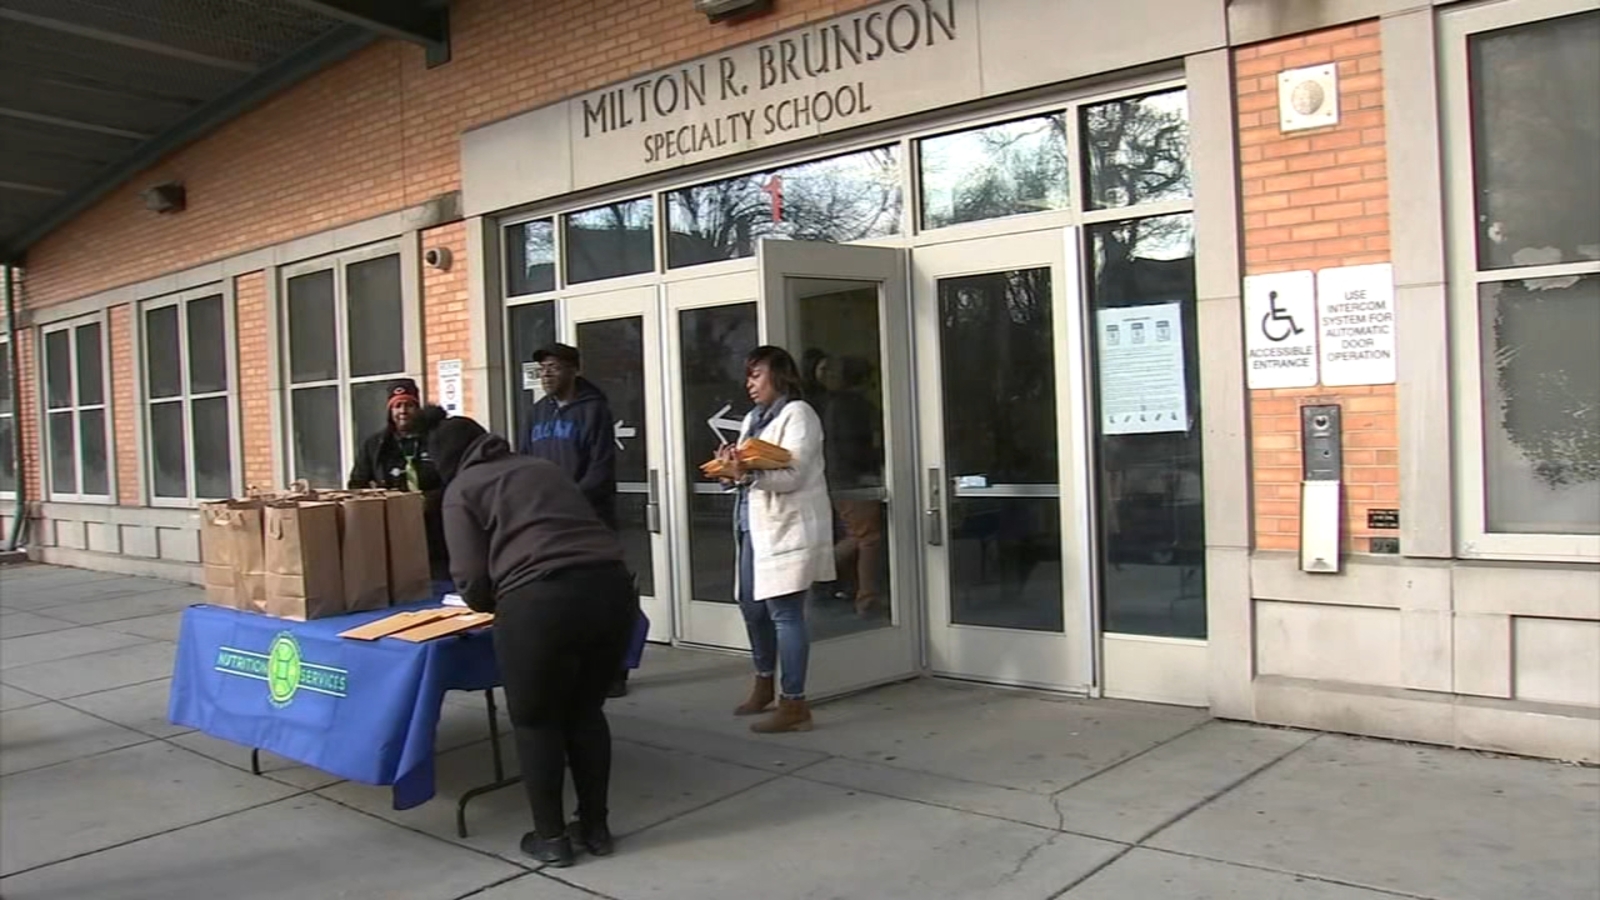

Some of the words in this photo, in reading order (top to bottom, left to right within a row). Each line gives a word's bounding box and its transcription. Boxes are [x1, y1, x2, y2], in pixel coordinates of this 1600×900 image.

[582, 64, 706, 138] MILTON
[719, 56, 749, 101] R.
[758, 0, 956, 90] BRUNSON
[644, 109, 755, 163] SPECIALTY
[764, 82, 872, 135] SCHOOL
[762, 174, 784, 224] 1
[1344, 290, 1367, 300] USE
[1327, 301, 1386, 313] INTERCOM
[1322, 314, 1367, 326] SYSTEM
[1369, 312, 1393, 323] FOR
[1326, 325, 1390, 337] AUTOMATIC
[1341, 338, 1375, 349] DOOR
[1249, 345, 1314, 358] ACCESSIBLE
[1327, 350, 1391, 362] OPERATION
[1253, 358, 1310, 370] ENTRANCE
[218, 653, 268, 673] NUTRITION
[300, 669, 346, 691] SERVICES
